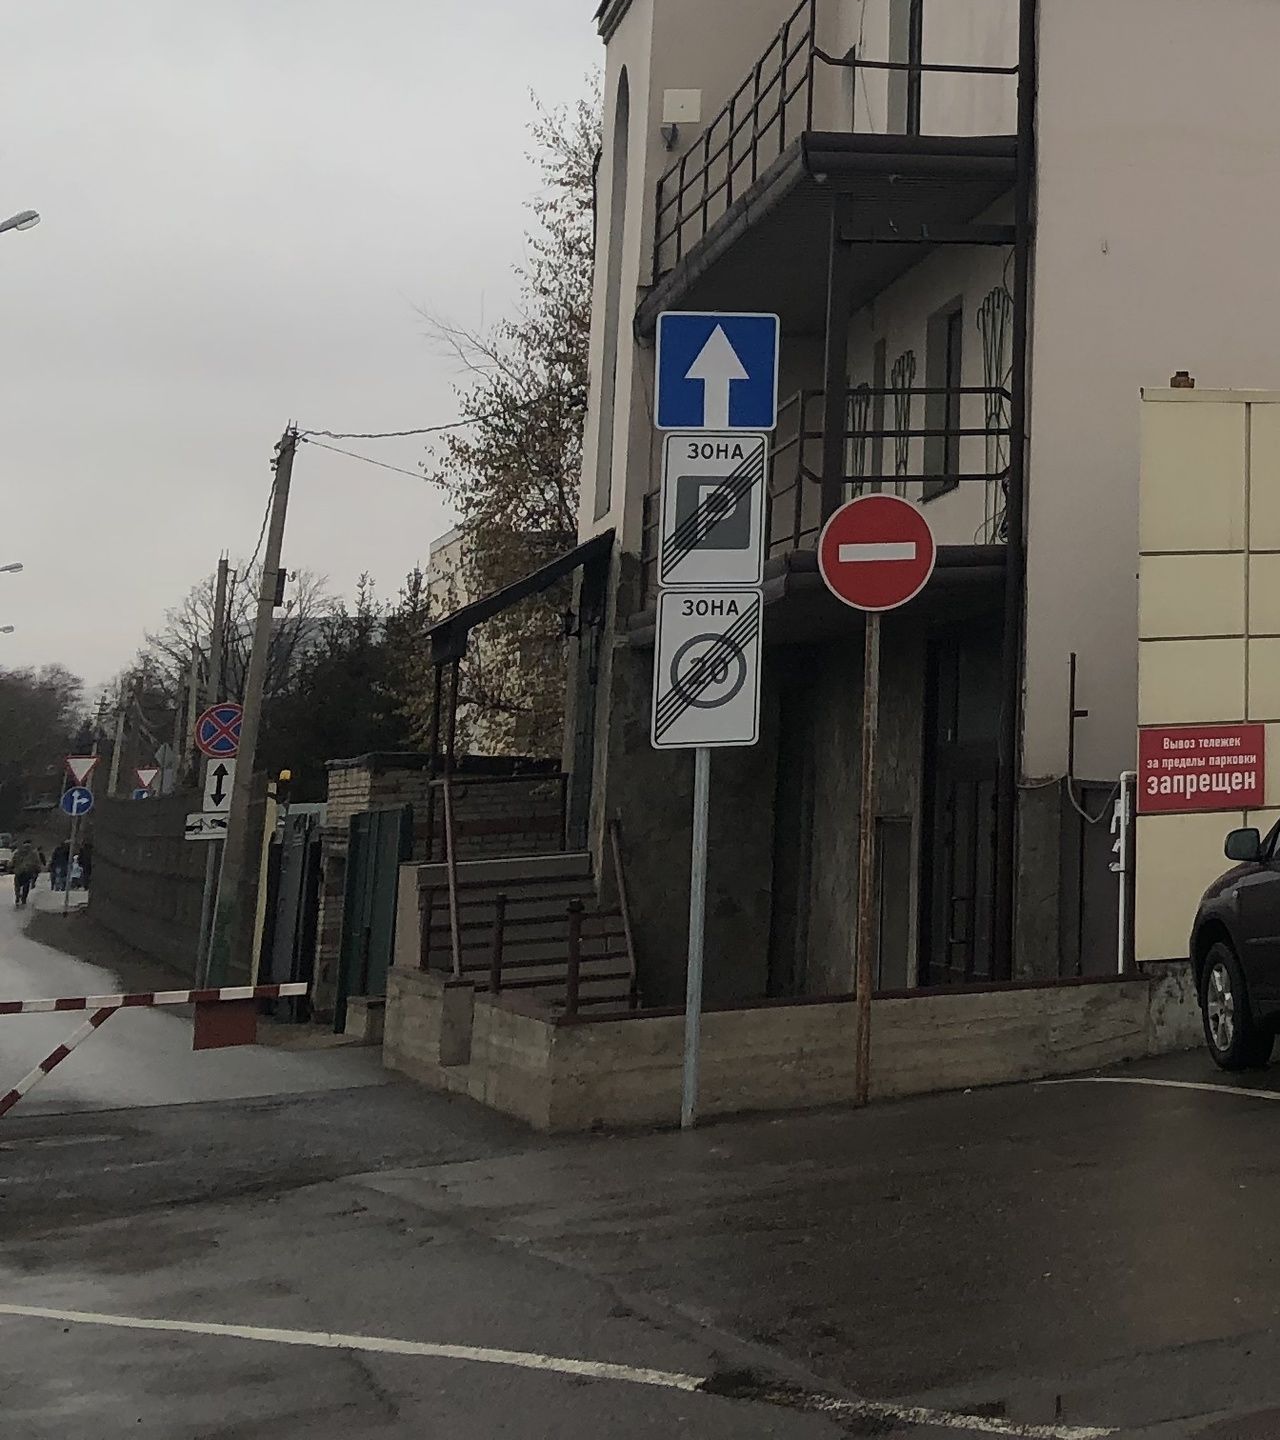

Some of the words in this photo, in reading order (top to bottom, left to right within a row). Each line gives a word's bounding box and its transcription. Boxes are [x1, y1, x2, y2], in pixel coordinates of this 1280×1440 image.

[687, 442, 745, 460] ЗОНА
[682, 599, 739, 616] ЗОНА
[1163, 737, 1195, 750] Вывоз
[1199, 736, 1241, 748] тележек
[1147, 759, 1159, 769] за
[1162, 757, 1205, 770] пределы
[1209, 754, 1257, 768] парковки
[1147, 771, 1256, 799] запрещен
